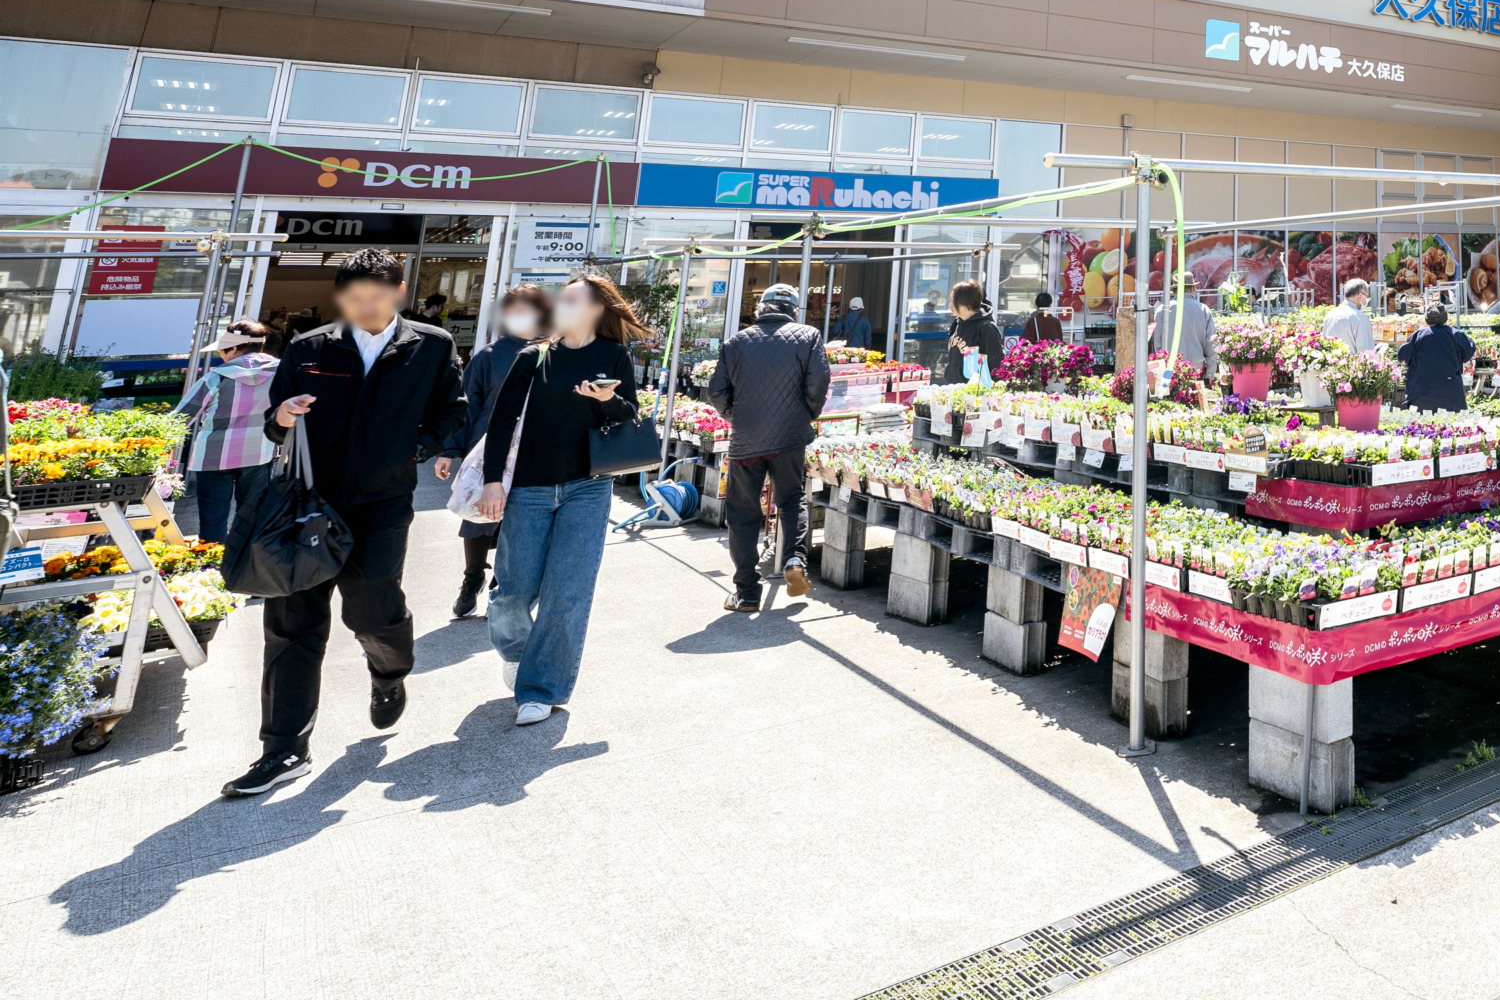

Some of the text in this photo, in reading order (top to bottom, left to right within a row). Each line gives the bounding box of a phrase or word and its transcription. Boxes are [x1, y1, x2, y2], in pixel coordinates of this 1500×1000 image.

[1249, 21, 1291, 37] スーパー
[1244, 35, 1405, 82] マルハチ 大久保店
[758, 173, 810, 188] SUPER
[534, 231, 573, 240] 営業時間
[106, 275, 140, 283] 危険物品
[100, 283, 142, 291] 持込み厳禁
[1456, 461, 1481, 472] ペチュニア
[1390, 469, 1416, 480] ペチュニア
[1341, 605, 1374, 619] ペチュニア
